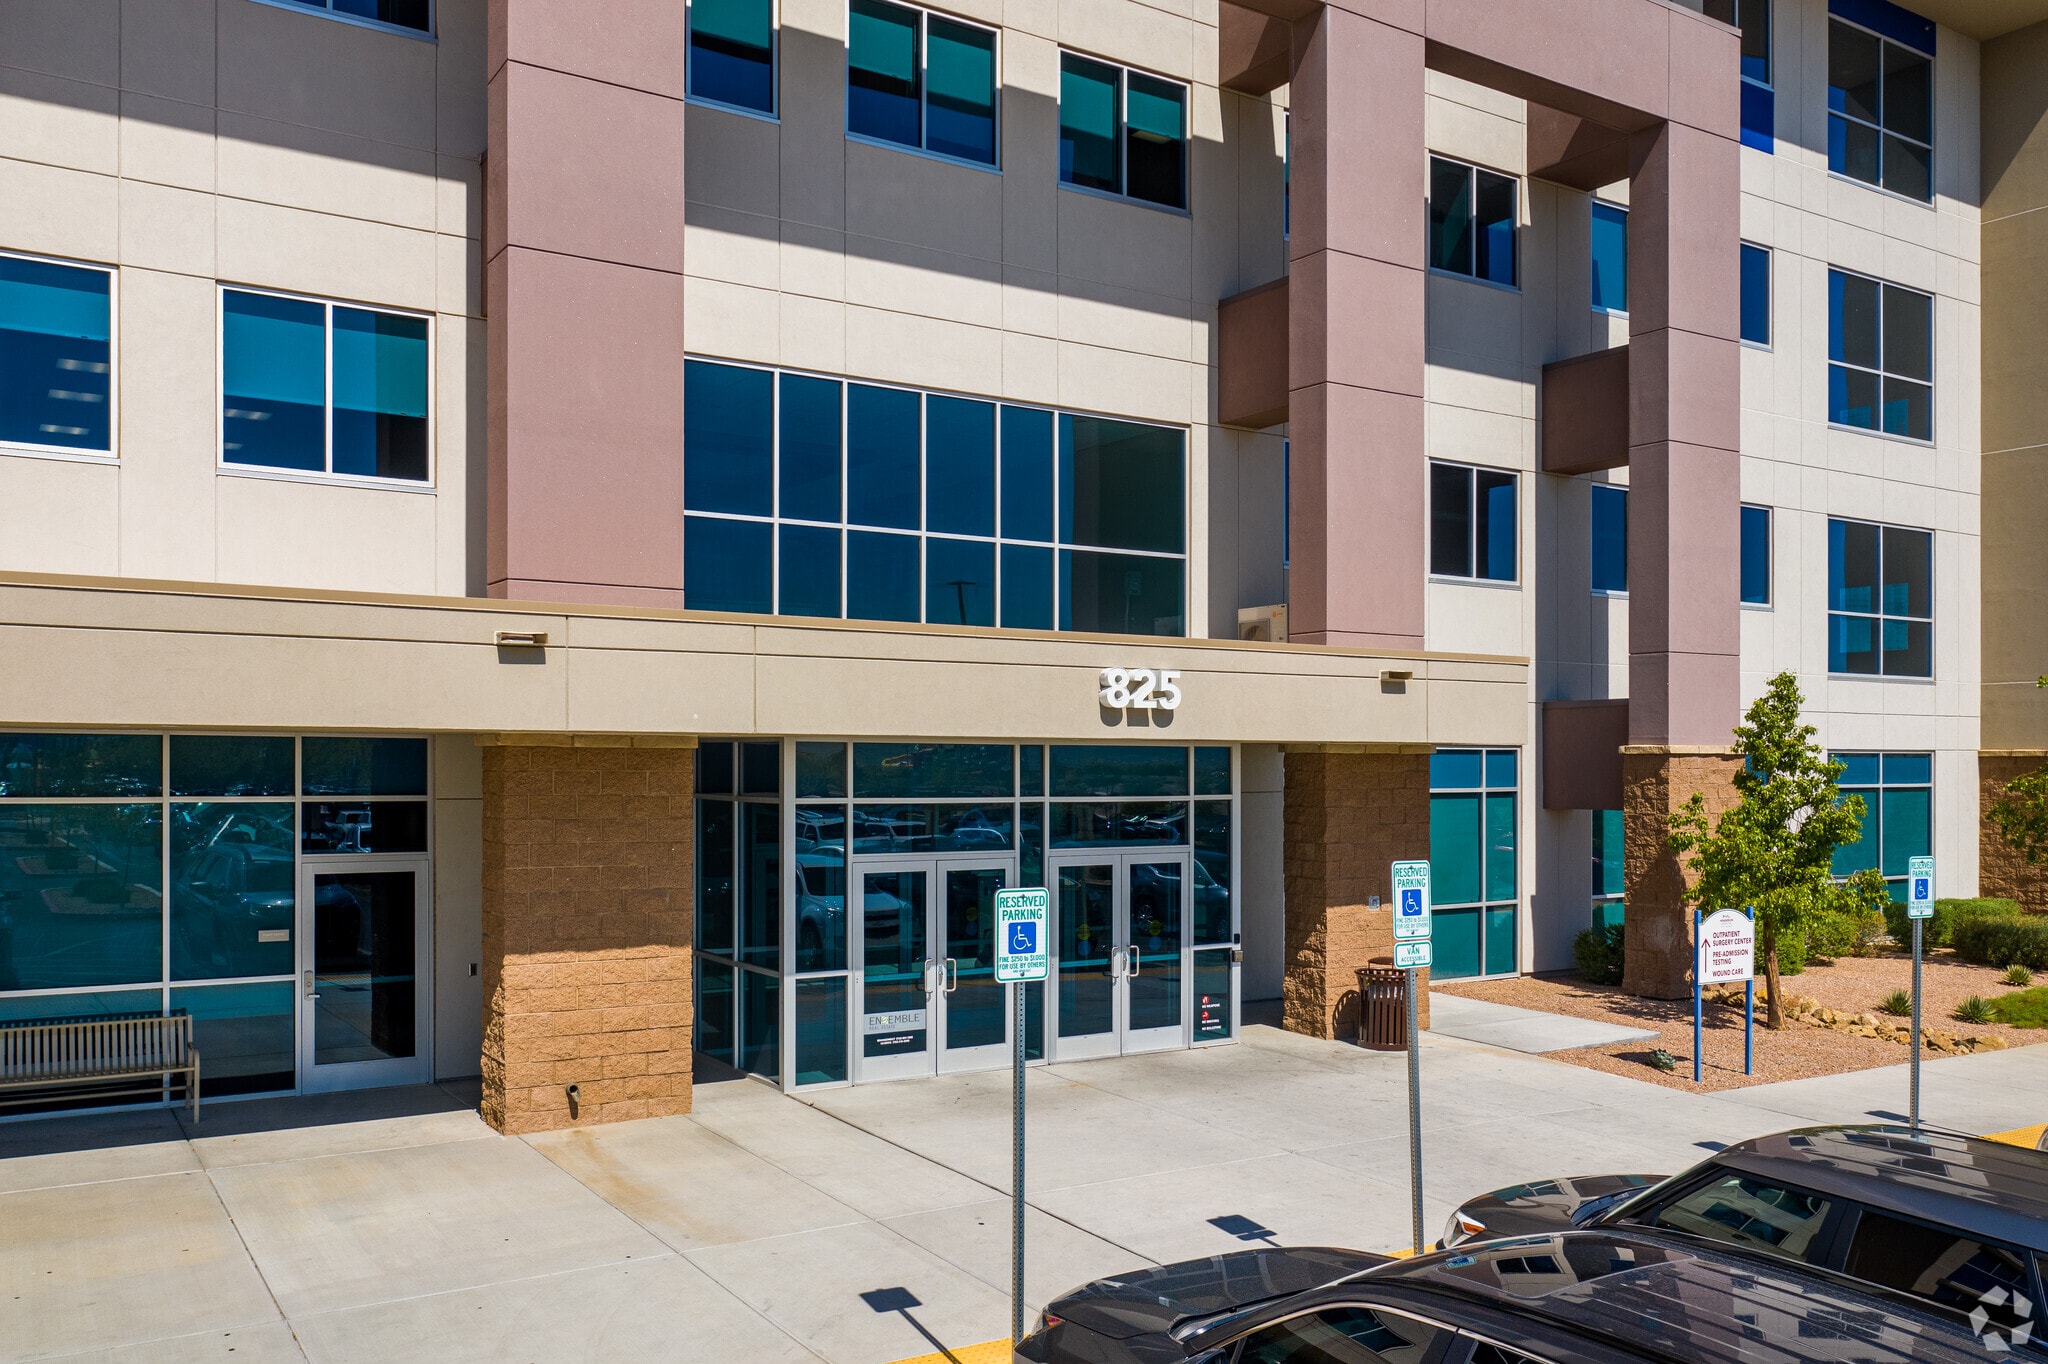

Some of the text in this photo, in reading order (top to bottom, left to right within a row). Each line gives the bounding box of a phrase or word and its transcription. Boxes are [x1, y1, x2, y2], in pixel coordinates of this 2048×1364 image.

[1099, 667, 1182, 710] 825
[1395, 867, 1428, 878] RESERVED
[1397, 878, 1426, 888] PARKING
[999, 895, 1045, 908] RESERVED
[1002, 909, 1043, 921] PARKING
[1734, 937, 1752, 945] CENTER
[1406, 946, 1420, 955] VAN
[1712, 949, 1749, 957] PRE-ADMISSION
[1712, 958, 1731, 966] TESTING
